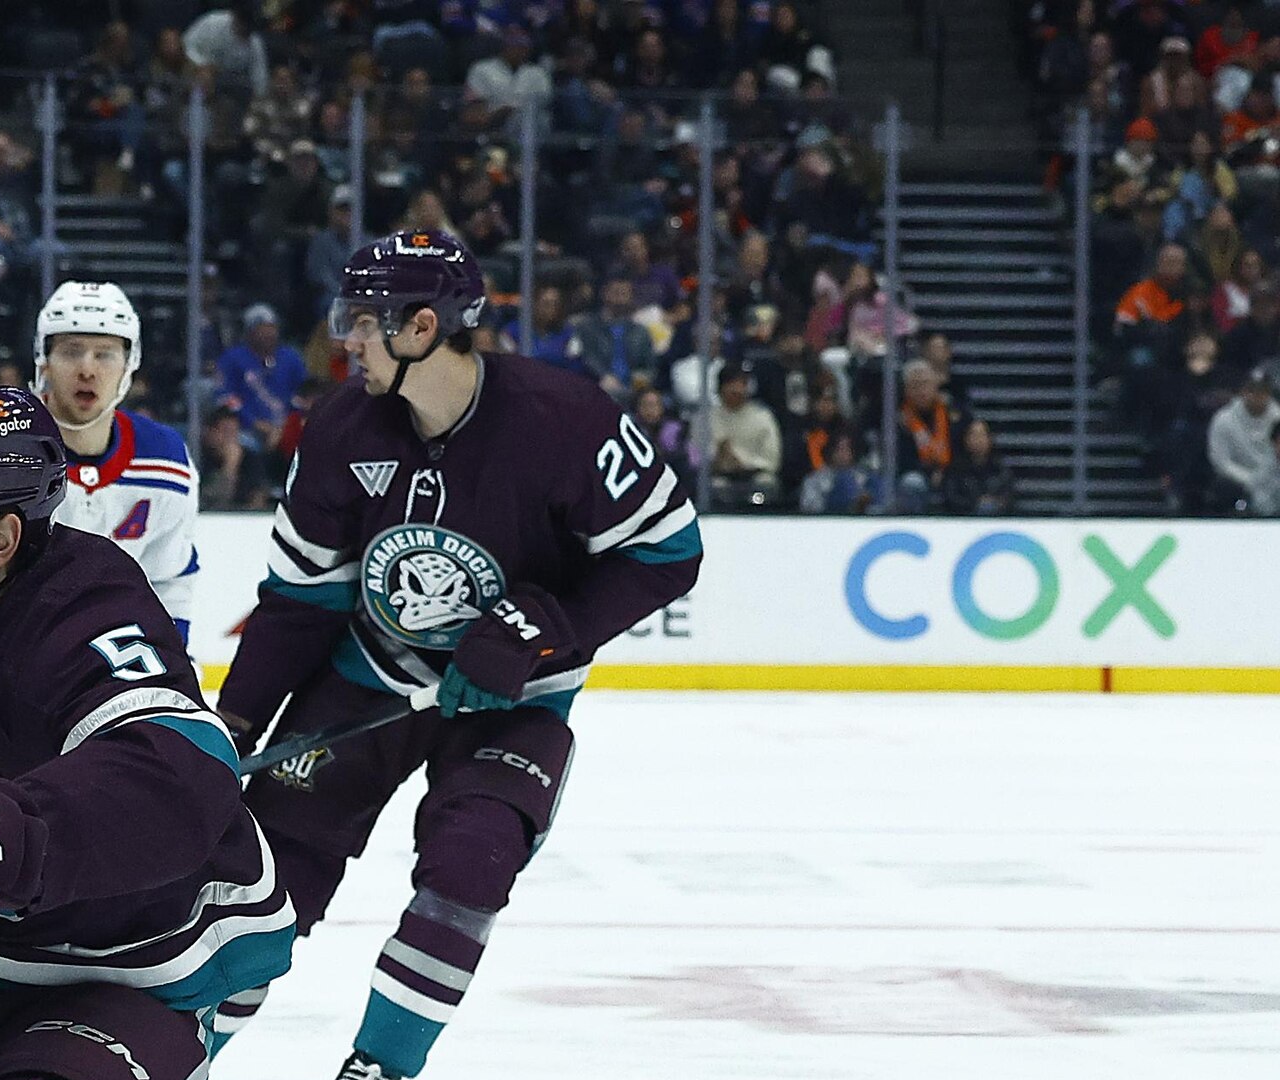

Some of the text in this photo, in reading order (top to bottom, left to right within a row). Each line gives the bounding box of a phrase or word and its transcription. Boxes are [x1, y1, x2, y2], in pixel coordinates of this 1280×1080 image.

[596, 413, 655, 500] 20
[113, 499, 151, 540] A
[367, 530, 500, 598] ANAHEIM DUCKS
[845, 530, 1178, 642] COX
[492, 599, 541, 641] CM
[88, 624, 168, 682] 5
[474, 747, 552, 789] CCM
[25, 1020, 151, 1080] CCM
